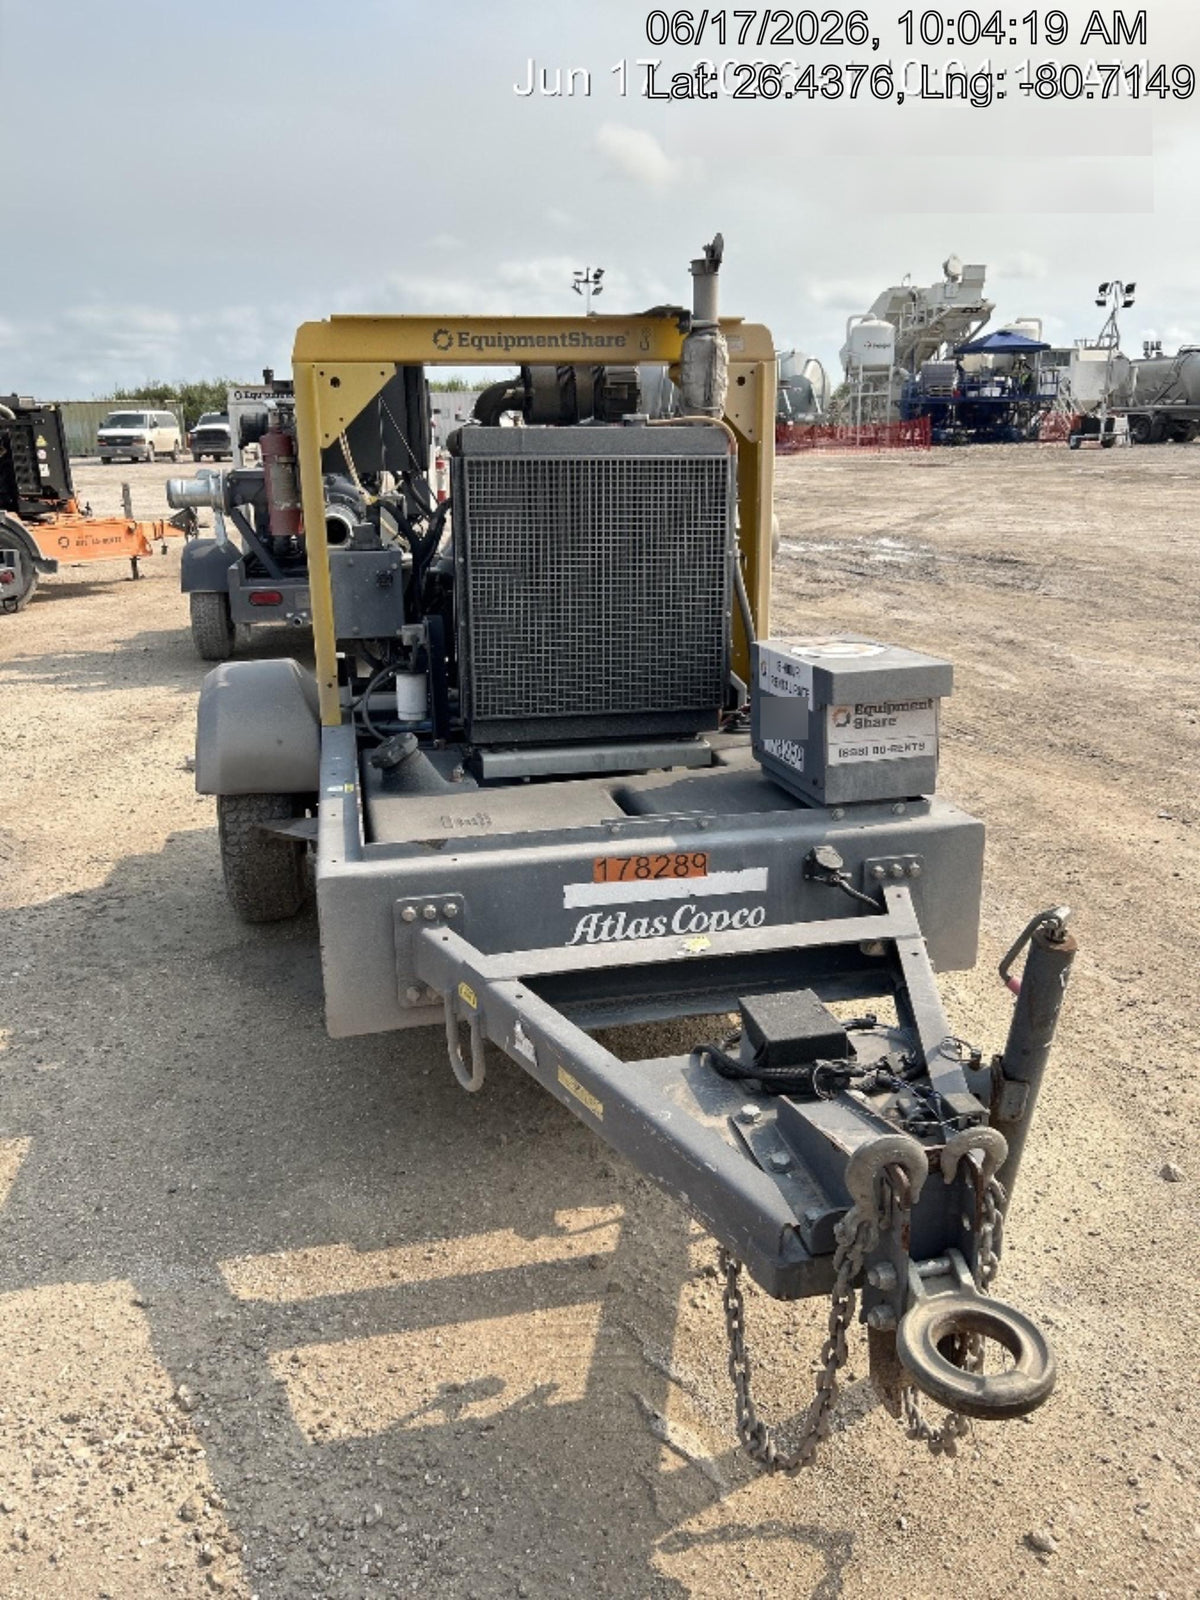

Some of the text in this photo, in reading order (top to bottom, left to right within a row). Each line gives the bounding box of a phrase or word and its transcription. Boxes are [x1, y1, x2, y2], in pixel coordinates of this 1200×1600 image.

[457, 331, 626, 351] EquipmentShare
[854, 698, 934, 717] Equipment
[853, 717, 897, 730] Share
[596, 853, 708, 881] 178289
[564, 904, 766, 945] Atlas Copco
